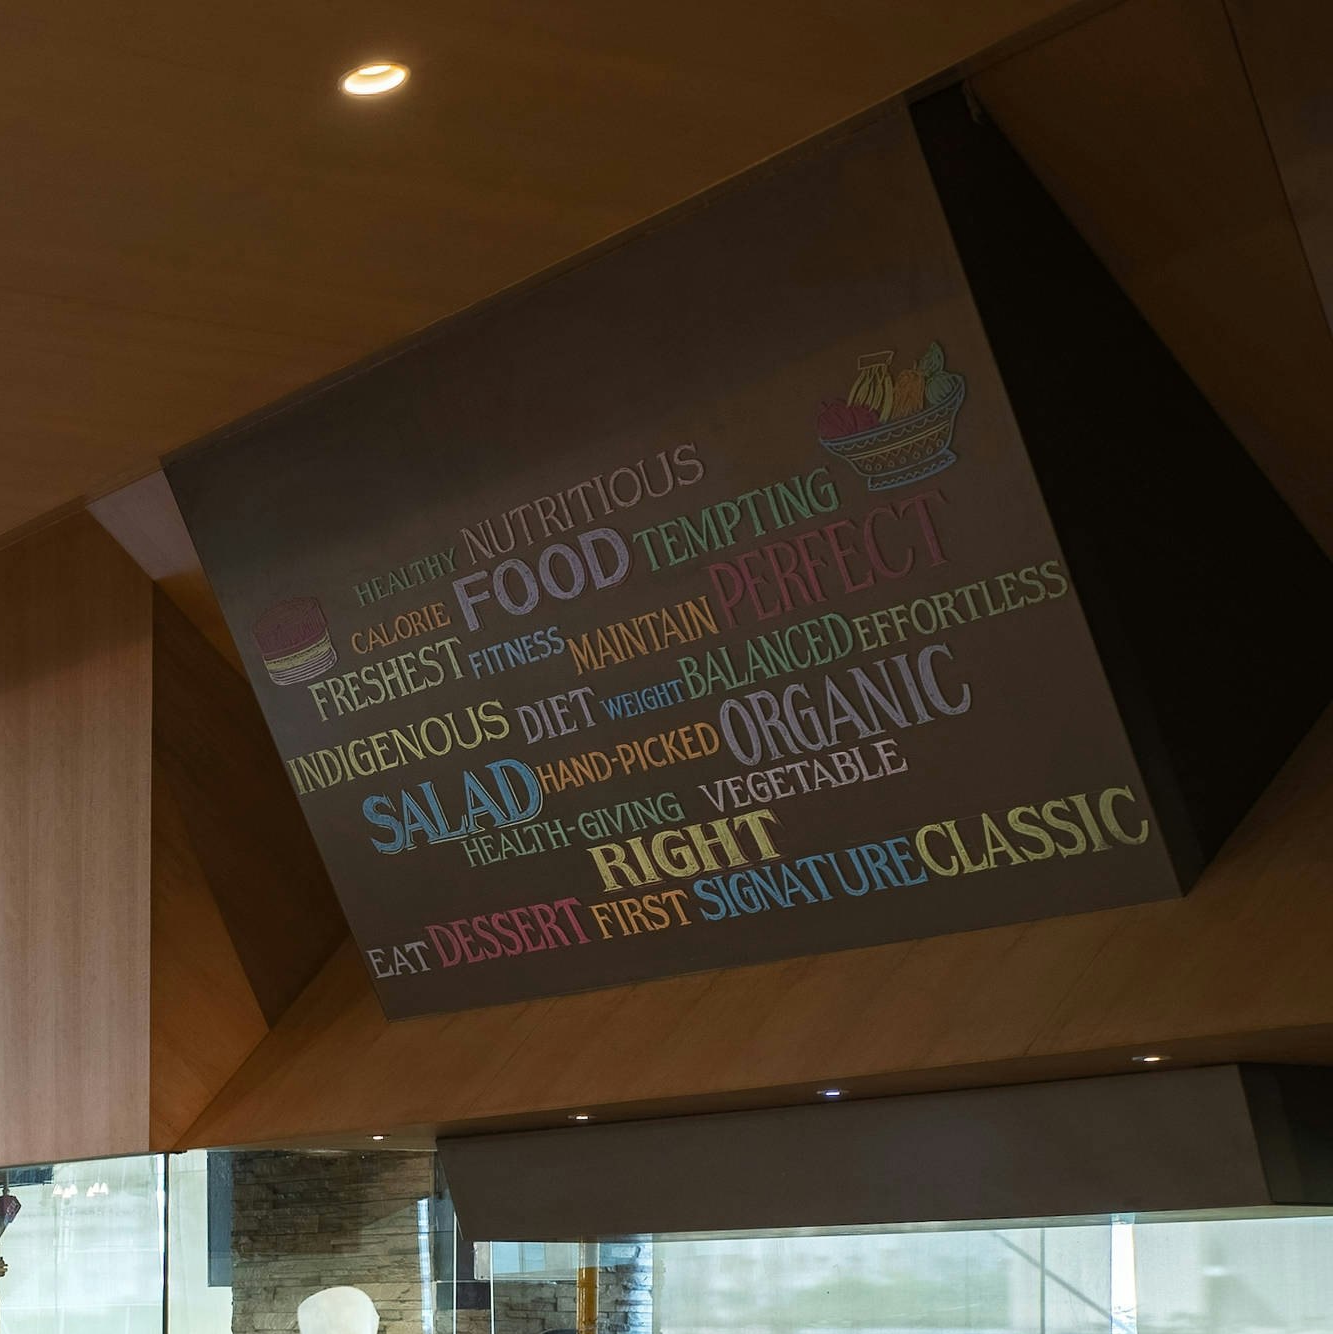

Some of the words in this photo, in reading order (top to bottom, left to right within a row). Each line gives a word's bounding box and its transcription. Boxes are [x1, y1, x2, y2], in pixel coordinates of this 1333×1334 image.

[308, 636, 466, 722] FRESHEST
[468, 626, 566, 680] FITNESS
[565, 595, 721, 676] MAINTAIN
[705, 488, 948, 627] PERFECT
[351, 602, 452, 655] CALORIE
[453, 527, 631, 631] FOOD
[633, 467, 839, 572] TEMPTING
[353, 547, 459, 608] HEALTHY
[459, 442, 706, 565] NUTRITIOUS
[286, 699, 511, 795] INDIGENOUS
[515, 686, 597, 745] DIET
[600, 679, 685, 721] WEIGHT
[677, 612, 854, 700] BALANCED
[852, 559, 1070, 652] EFFORTLESS
[362, 757, 544, 855] SALAD
[538, 721, 721, 794] HAND-PICKED
[719, 643, 972, 767] ORGANIC
[365, 940, 432, 979] EAT
[425, 897, 592, 968] DESSERT
[589, 889, 694, 940] FIRST
[692, 836, 928, 922] SIGNATURE
[915, 785, 1149, 877] CLASSIC
[461, 791, 686, 867] HEALTH-GIVING
[698, 738, 909, 812] VEGETABLE
[587, 808, 785, 893] RIGHT
